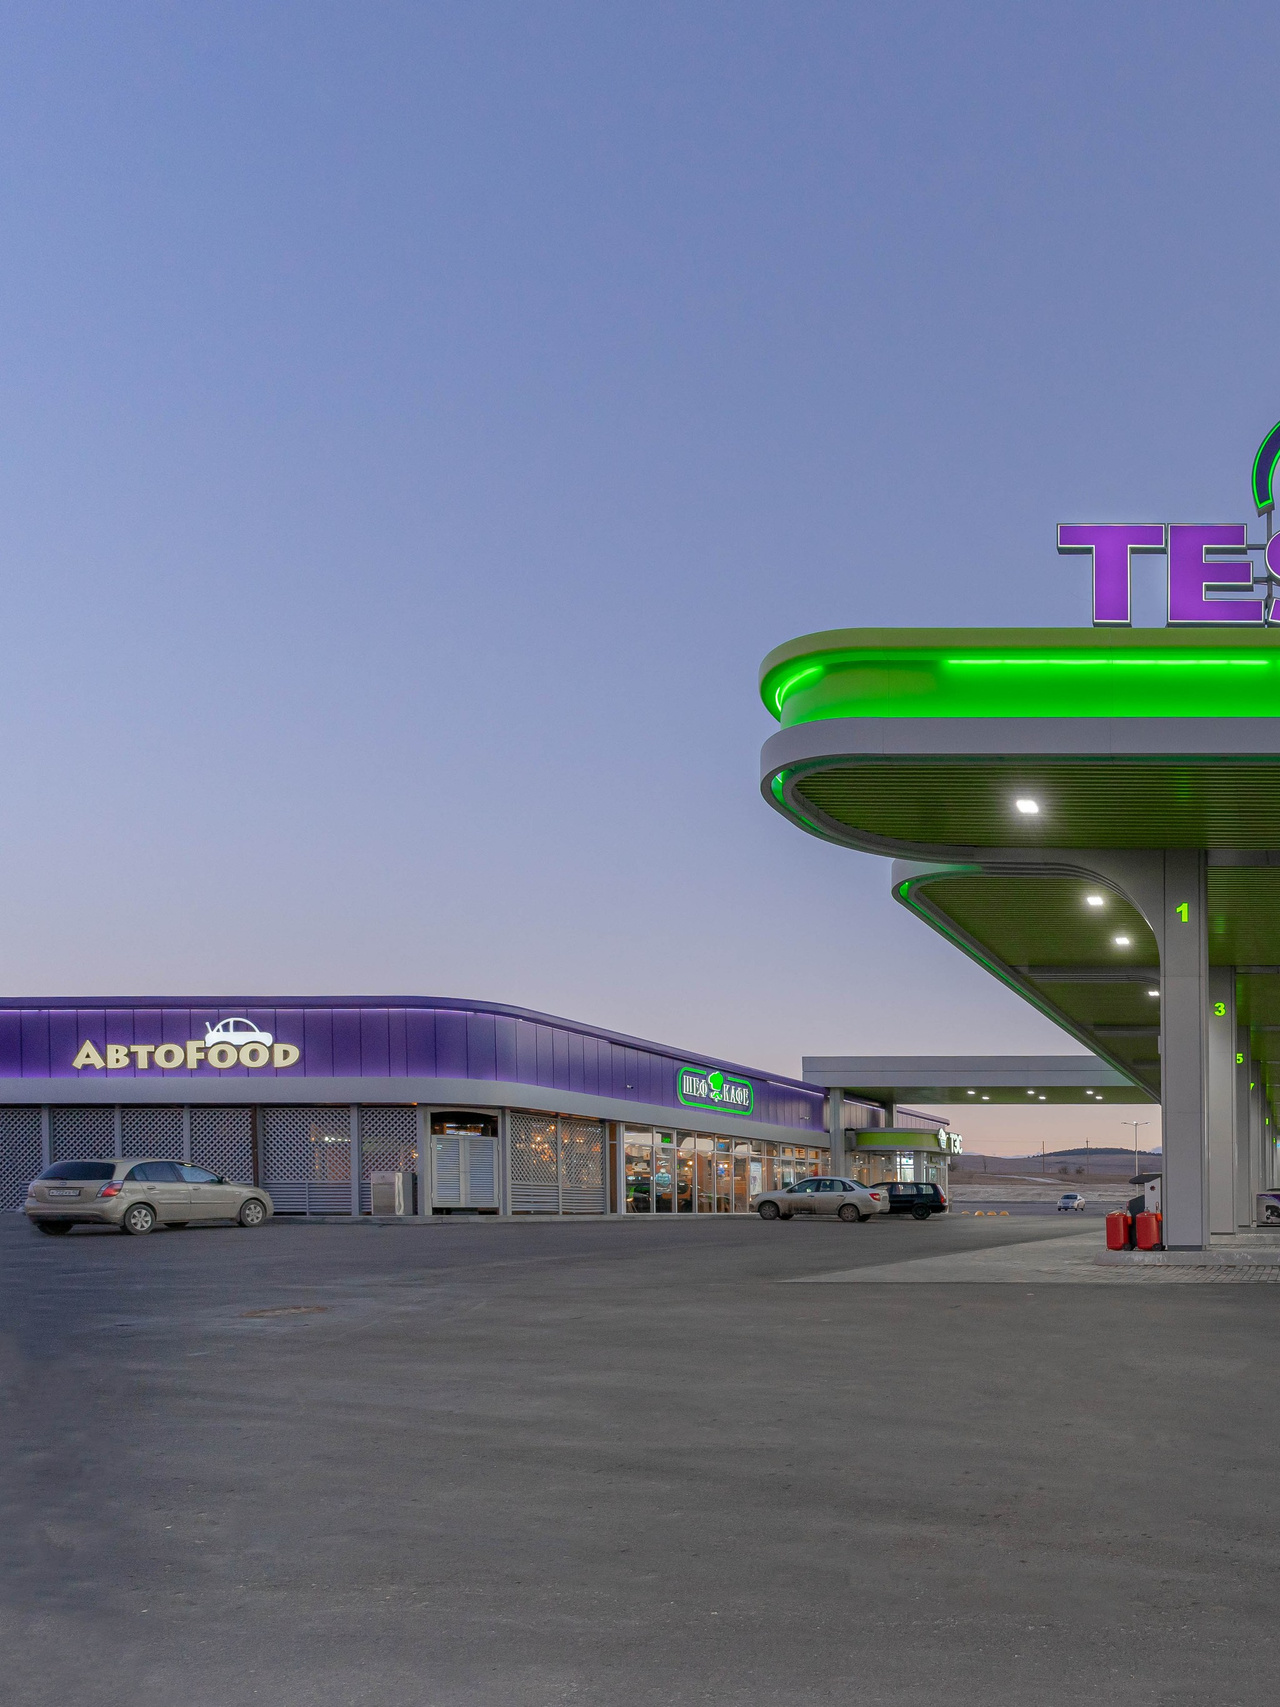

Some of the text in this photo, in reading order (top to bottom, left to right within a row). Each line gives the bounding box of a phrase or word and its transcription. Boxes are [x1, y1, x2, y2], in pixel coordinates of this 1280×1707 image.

[1175, 902, 1189, 923] 1
[1214, 1002, 1226, 1017] 3
[1236, 1053, 1244, 1064] 5
[683, 1075, 749, 1106] ШЕФ КАФЕ
